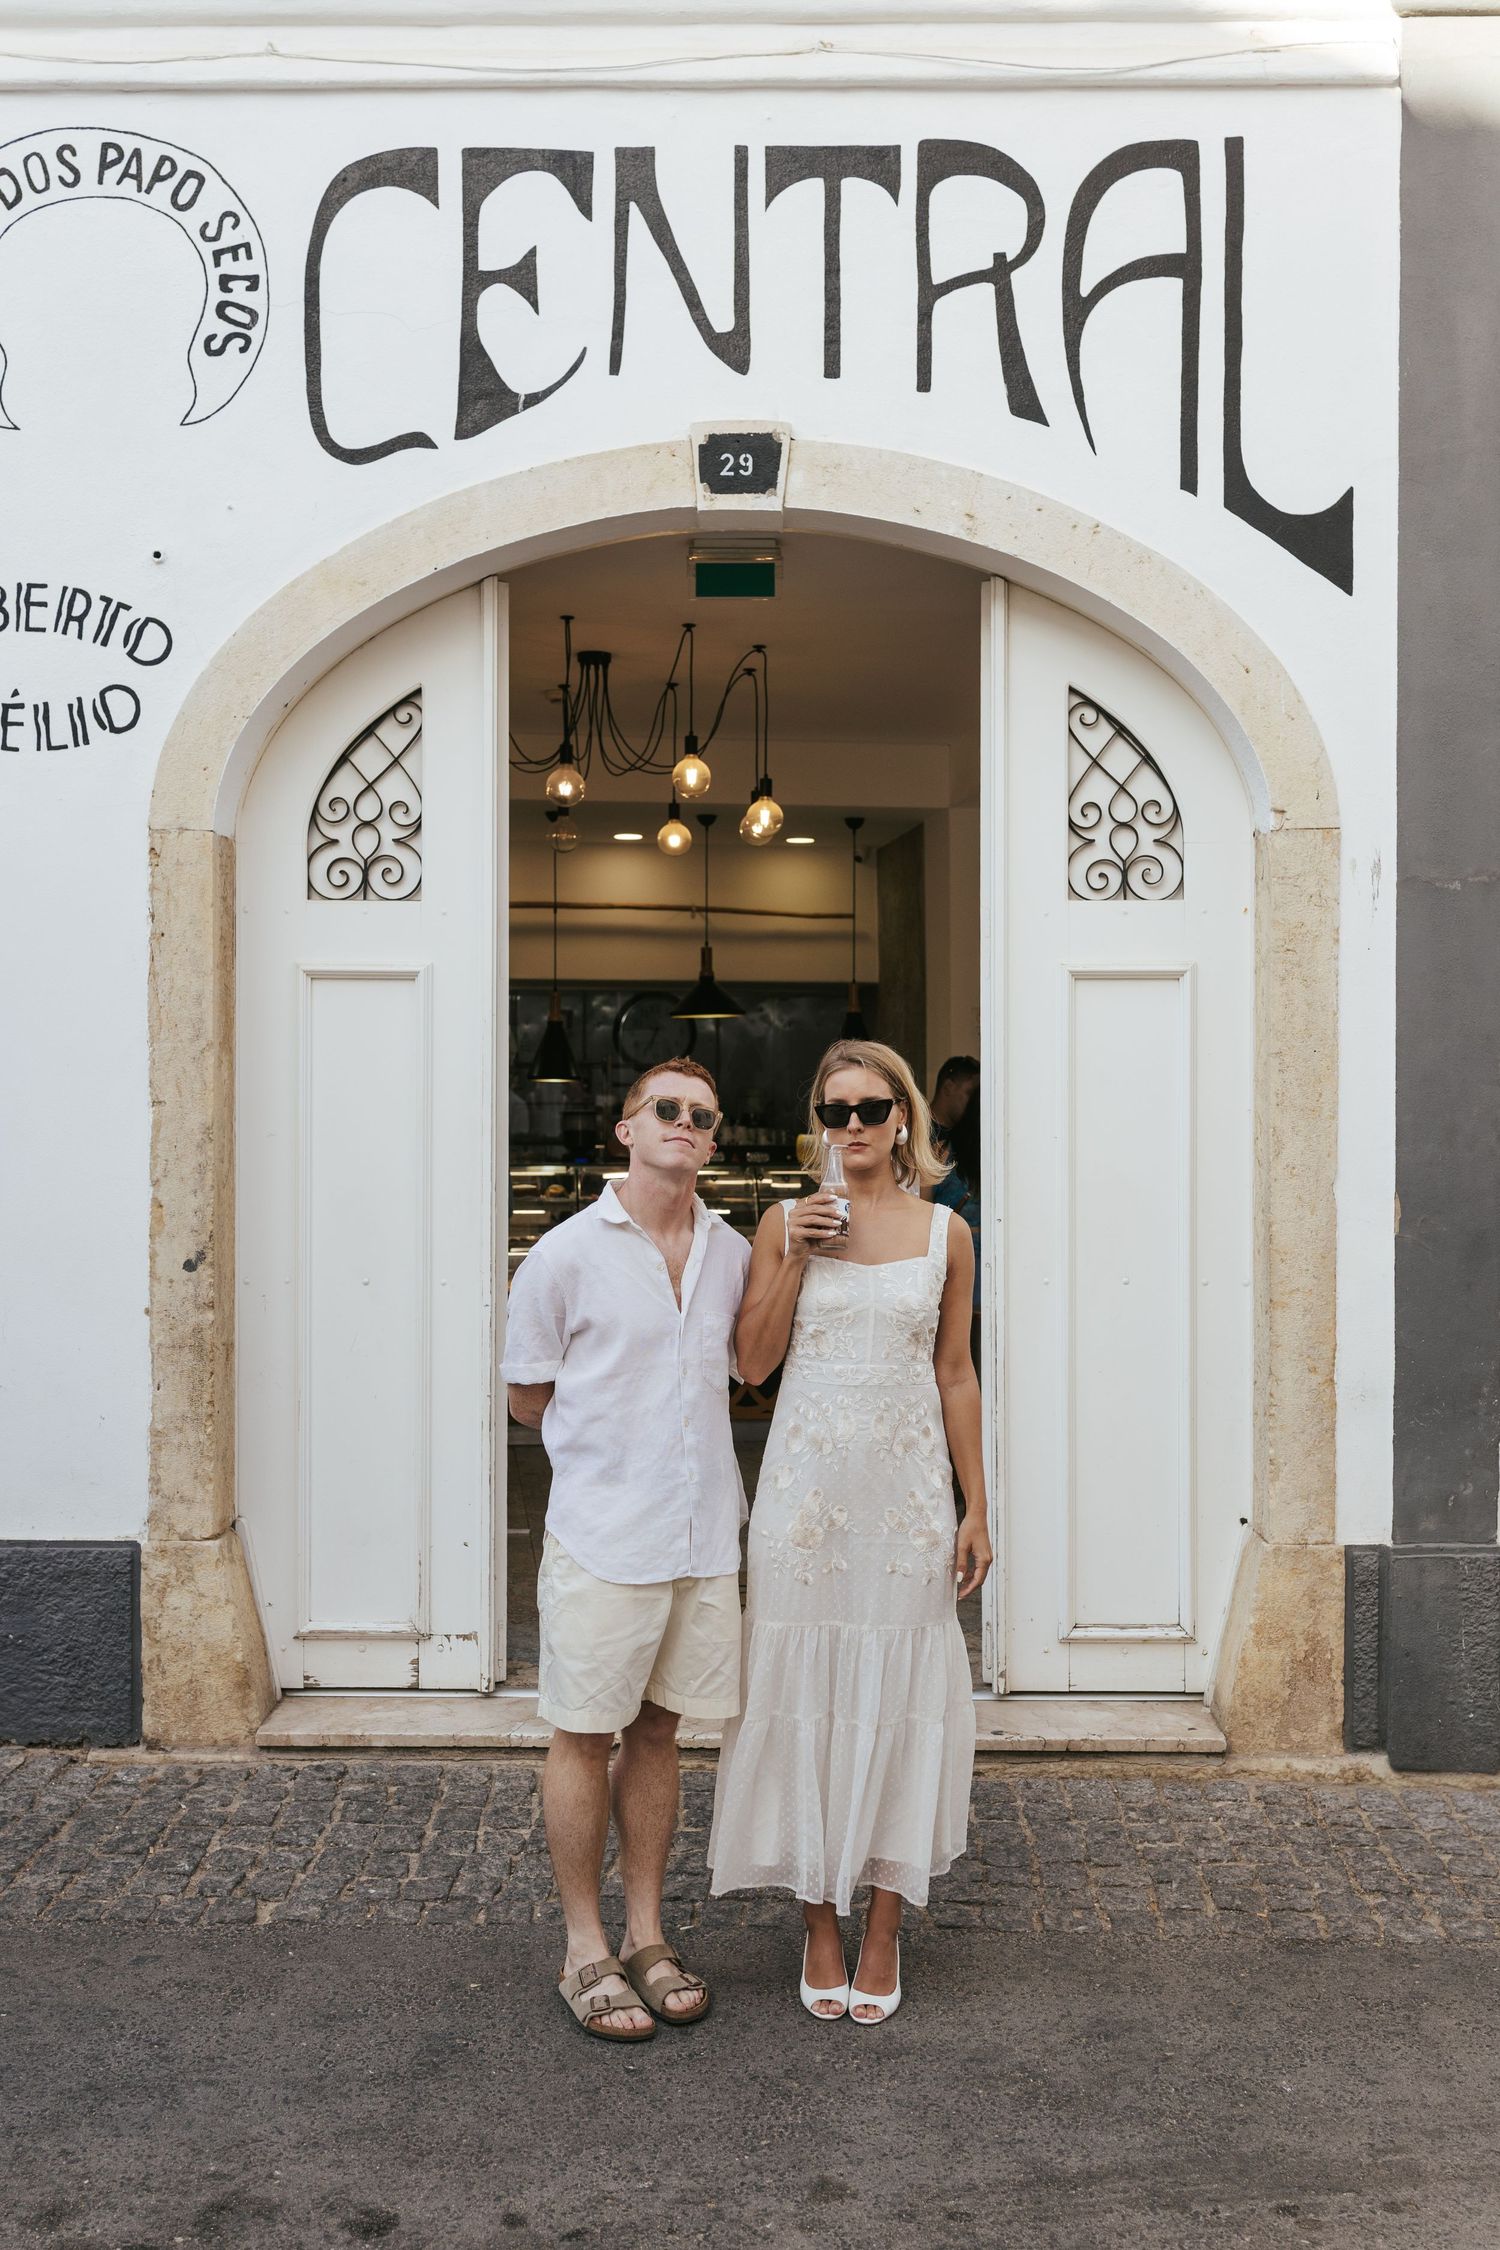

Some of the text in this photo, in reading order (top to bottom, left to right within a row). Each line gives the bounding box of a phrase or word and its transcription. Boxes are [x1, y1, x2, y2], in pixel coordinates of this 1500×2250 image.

[0, 141, 260, 357] DOS PAPO SECOS
[303, 136, 1354, 597] CENTRAL
[719, 453, 754, 476] 29
